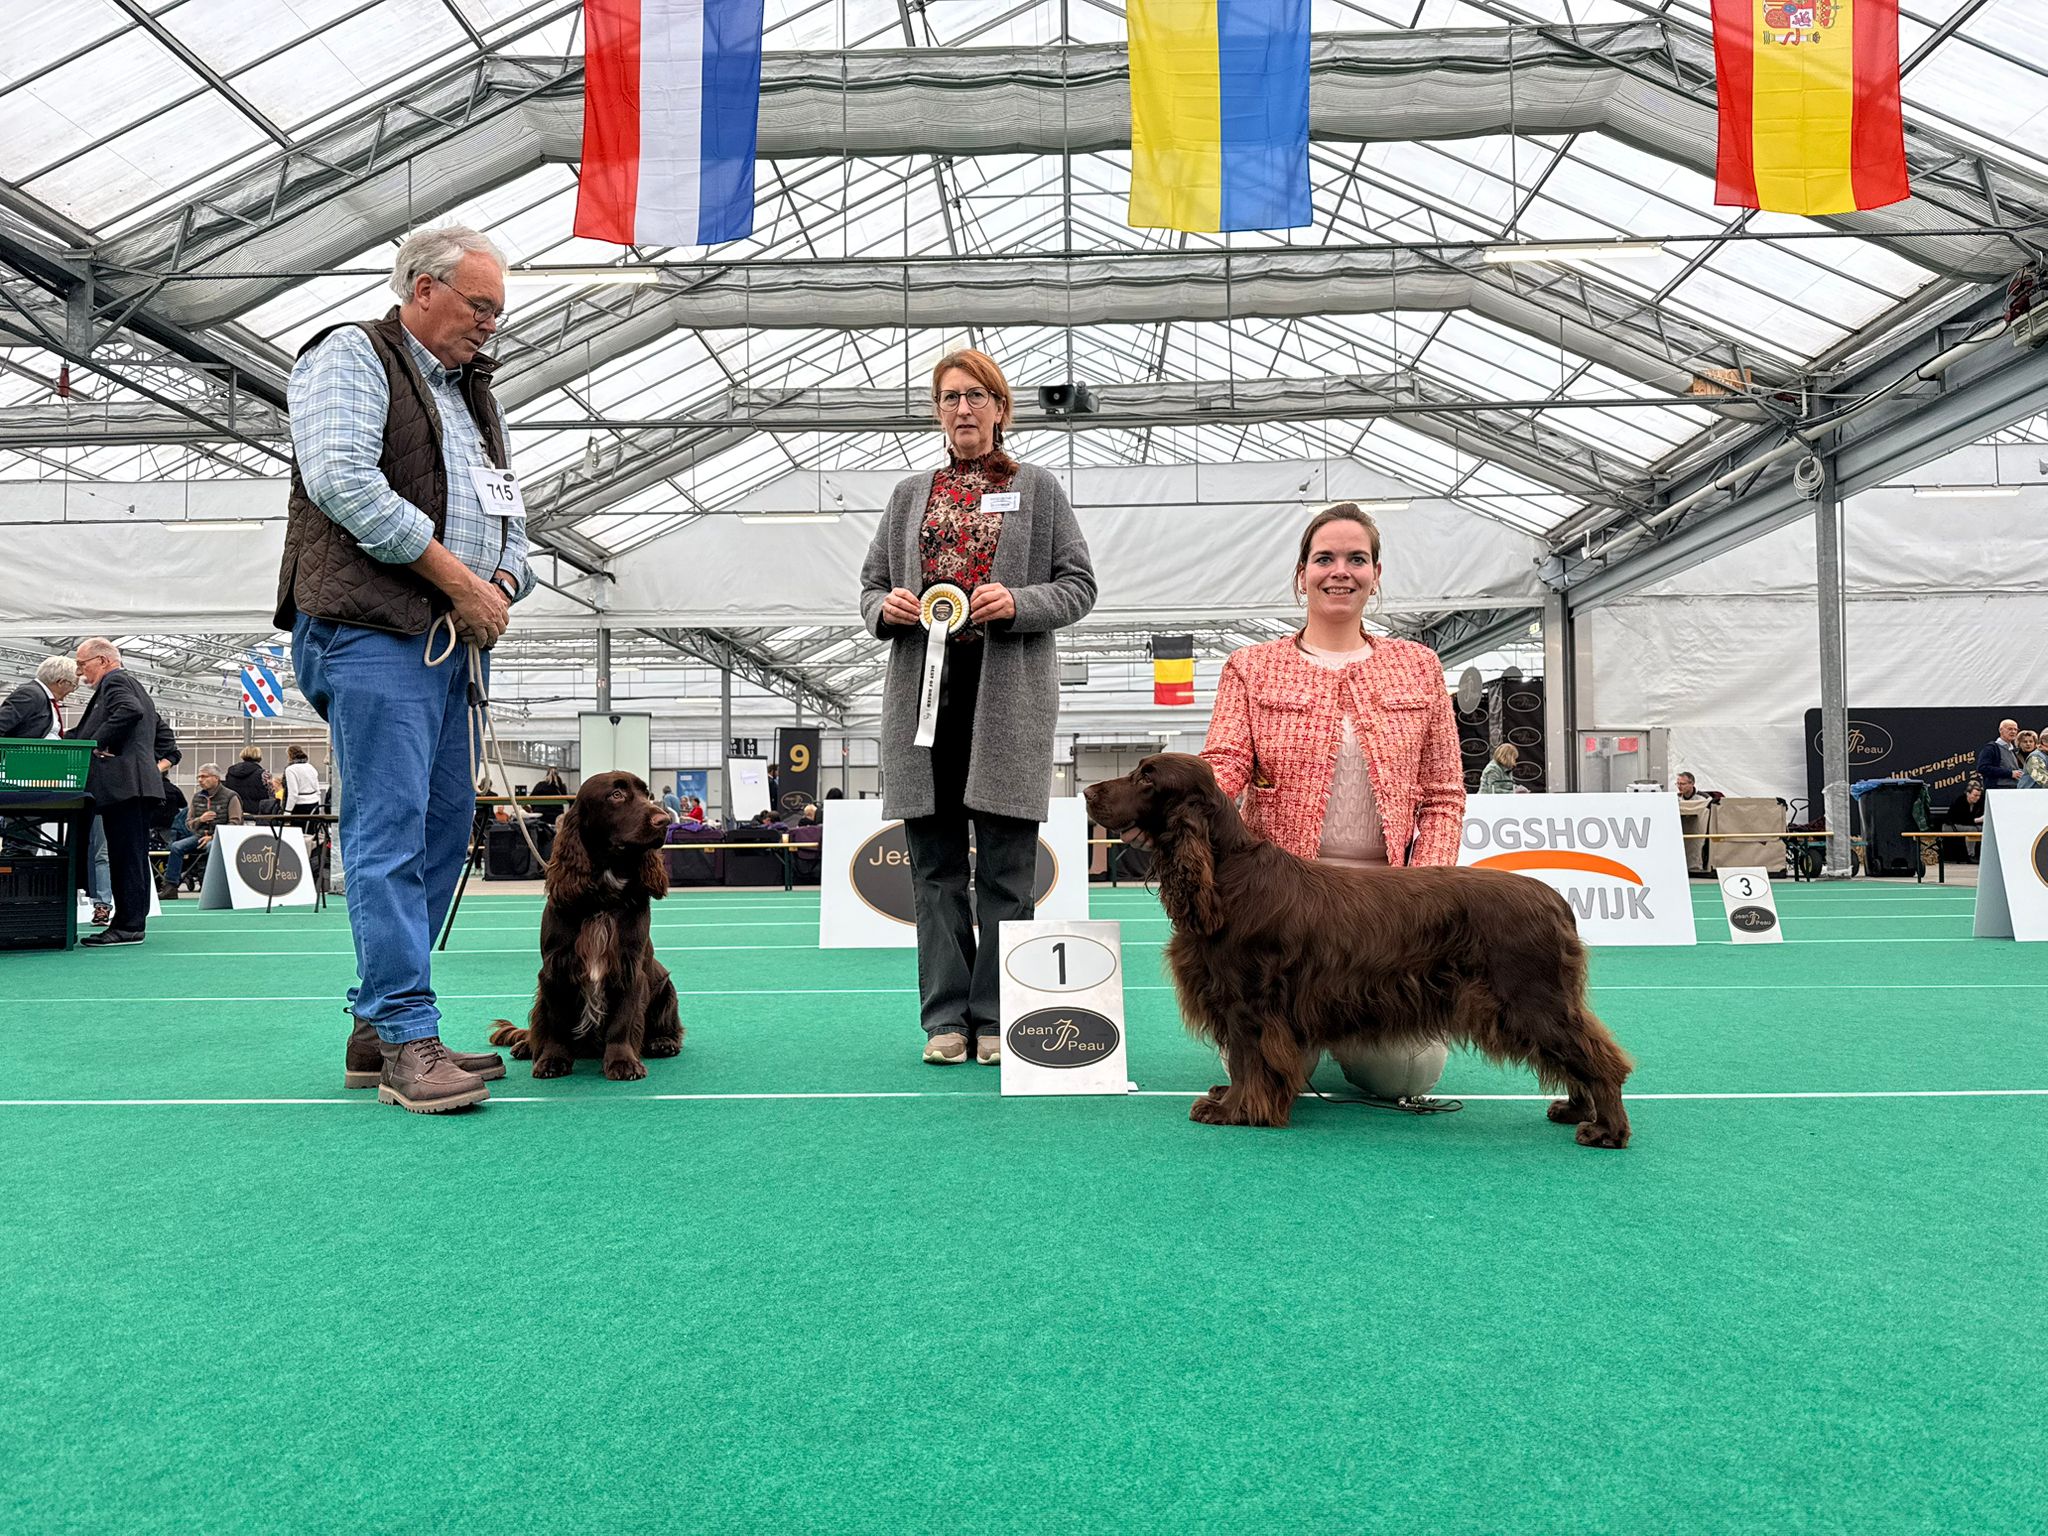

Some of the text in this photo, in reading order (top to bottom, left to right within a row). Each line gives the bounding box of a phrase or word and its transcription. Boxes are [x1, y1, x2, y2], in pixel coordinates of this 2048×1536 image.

[486, 484, 514, 501] 715
[790, 744, 810, 772] 9
[1856, 745, 1884, 754] Peau
[1888, 750, 1976, 779] htverzorging
[1934, 770, 1966, 790] moet
[1462, 817, 1651, 850] OGSHOW
[241, 852, 263, 863] Jean
[869, 845, 910, 866] Jea
[275, 869, 297, 880] Peau
[1740, 877, 1752, 896] 3
[1555, 887, 1655, 919] WIJK
[1052, 942, 1066, 985] 1
[1018, 1025, 1053, 1036] Jean
[1068, 1040, 1105, 1051] Peau
